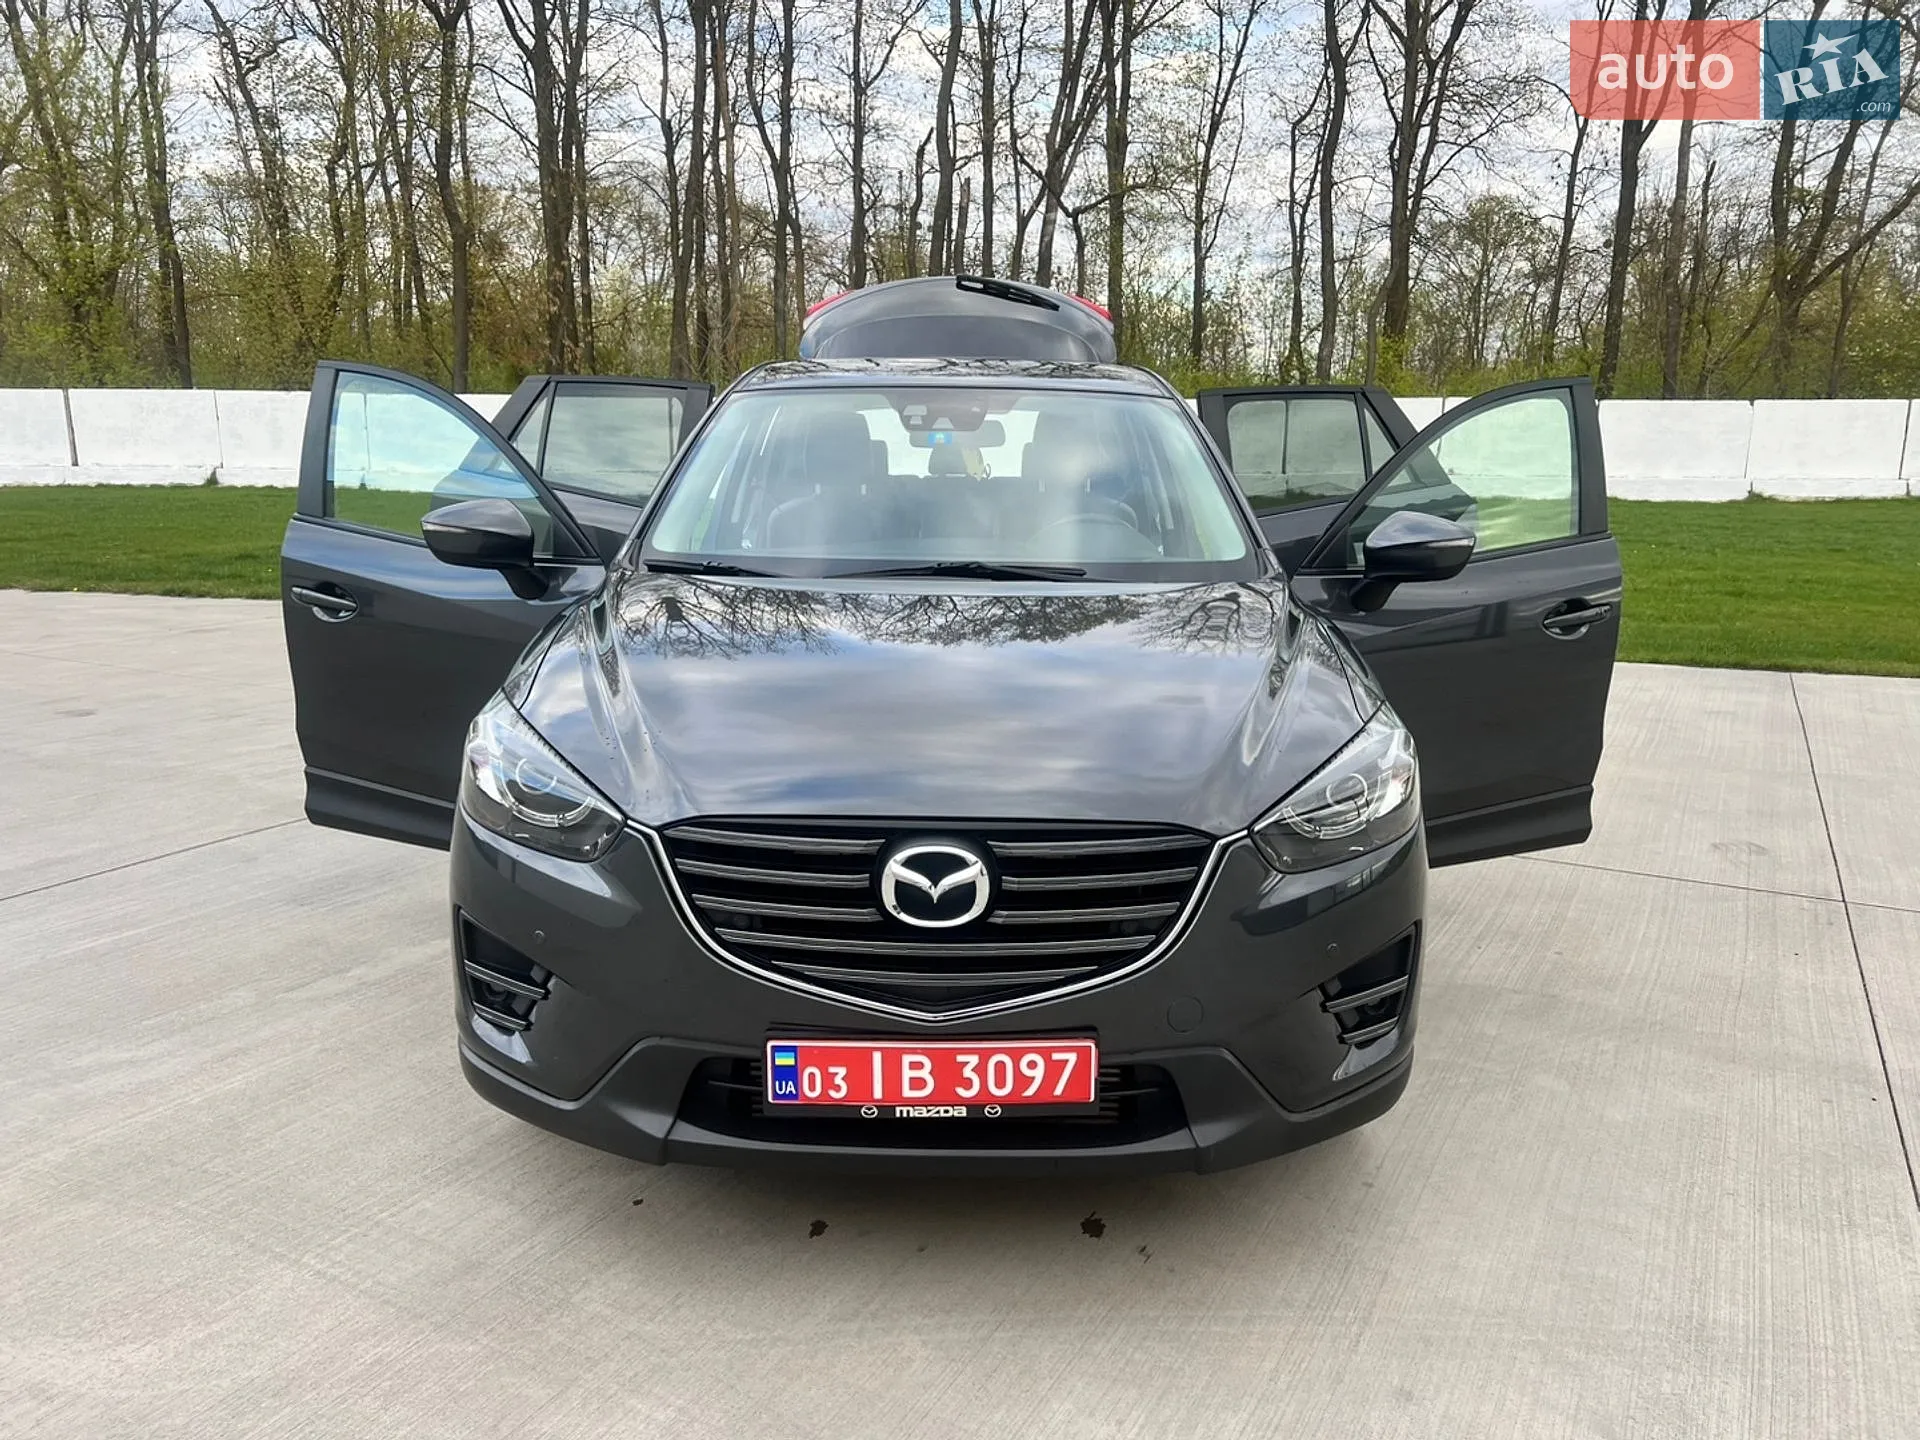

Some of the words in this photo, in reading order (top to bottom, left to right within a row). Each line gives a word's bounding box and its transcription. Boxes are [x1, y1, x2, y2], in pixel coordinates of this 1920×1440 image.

[775, 1080, 796, 1095] UA
[802, 1066, 848, 1099] 03
[872, 1051, 935, 1099] IB
[955, 1052, 1079, 1098] 3097
